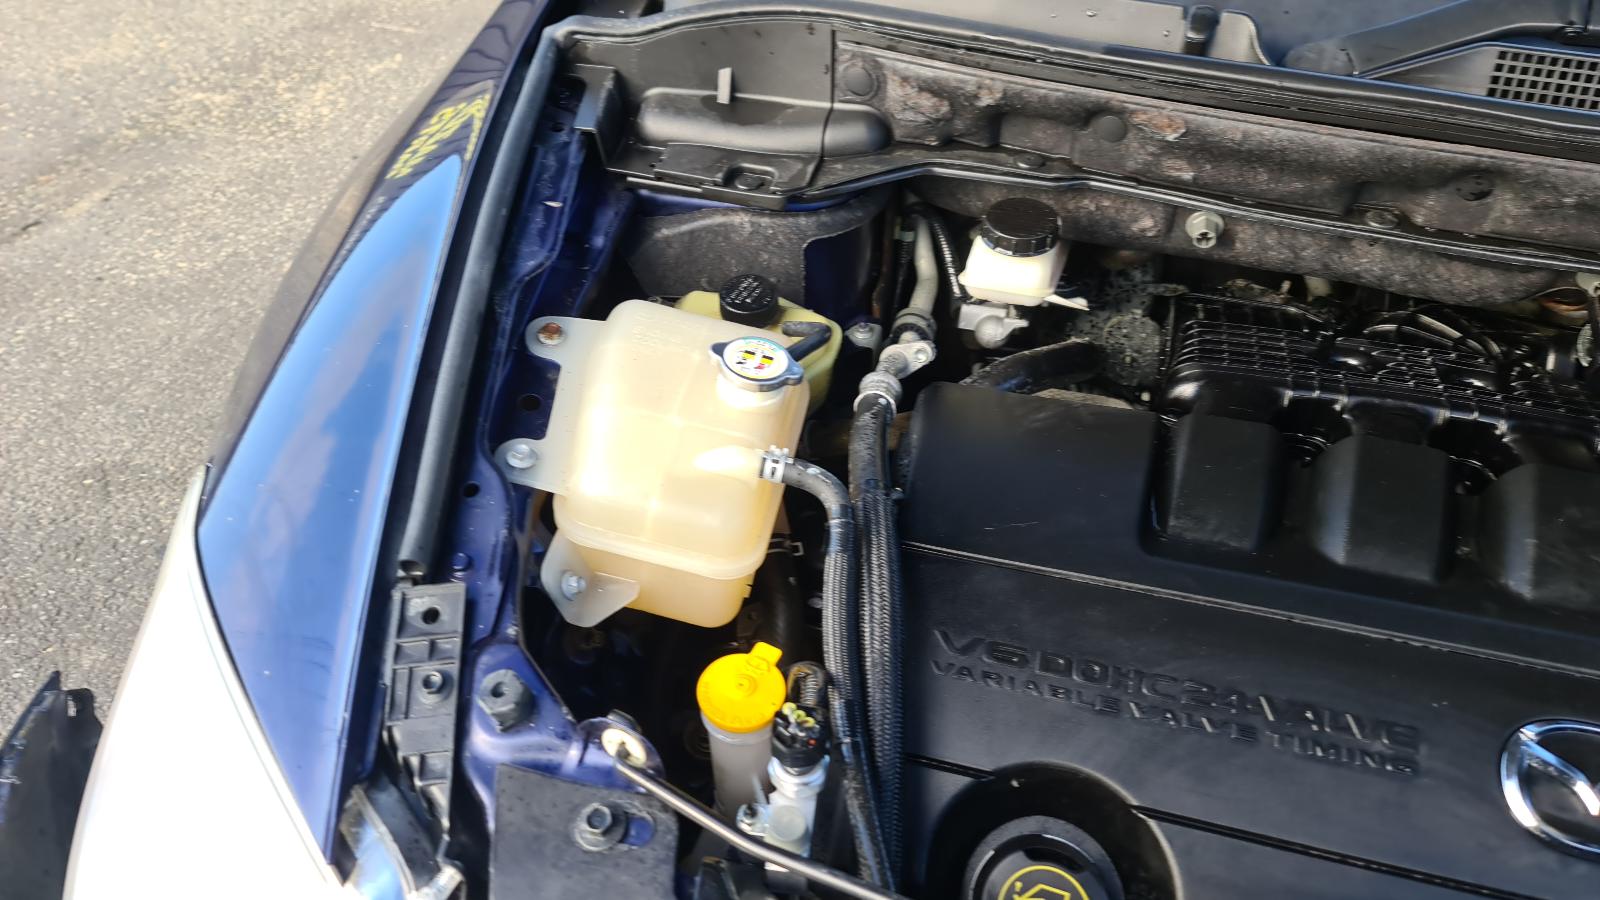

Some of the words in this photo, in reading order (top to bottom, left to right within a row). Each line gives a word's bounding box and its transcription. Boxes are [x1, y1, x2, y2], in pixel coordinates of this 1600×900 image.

[930, 659, 1121, 714] VARIABLE
[1127, 700, 1256, 743] VALVE
[1264, 730, 1418, 776] TIMING
